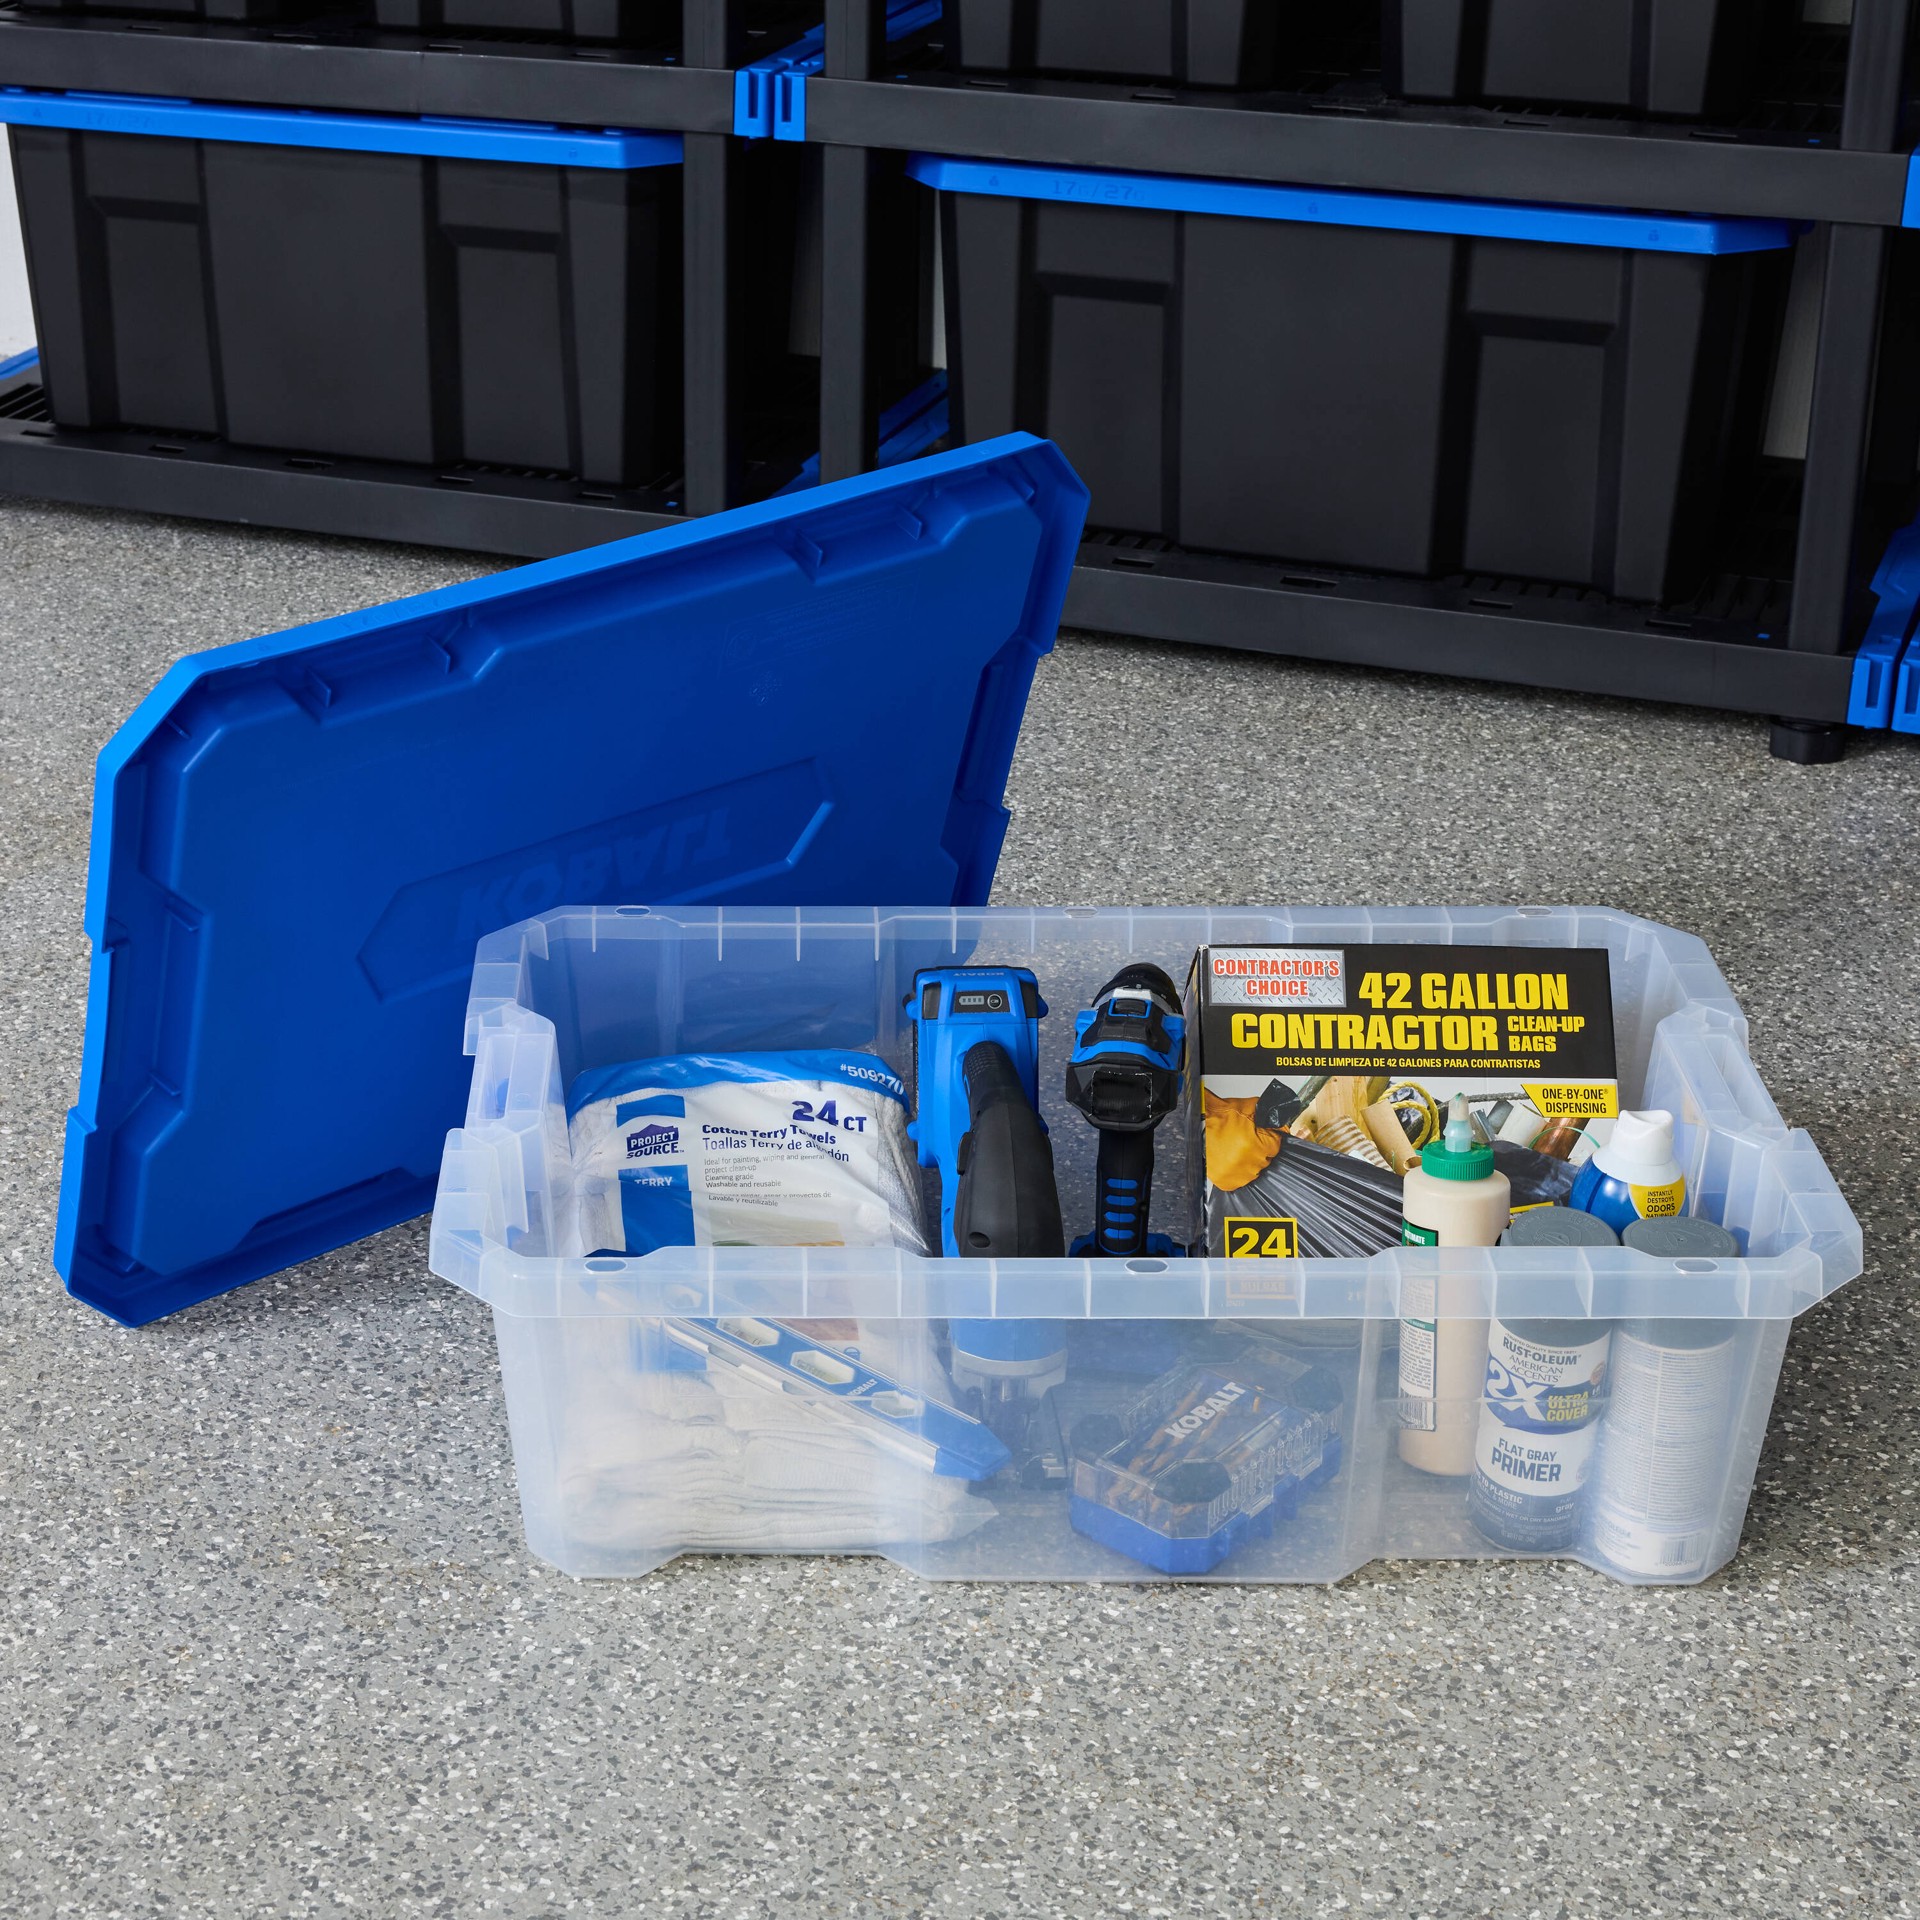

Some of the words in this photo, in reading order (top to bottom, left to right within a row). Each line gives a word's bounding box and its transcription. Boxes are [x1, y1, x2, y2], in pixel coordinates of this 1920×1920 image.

[1213, 959, 1341, 977] CONTRACTOR'S
[1246, 980, 1309, 996] CHOICE
[1358, 972, 1413, 1009] 42
[1420, 973, 1569, 1010] GALLON
[1231, 1013, 1499, 1051] CONTRACTOR
[1507, 1015, 1586, 1033] CLEAN-UP
[1508, 1035, 1557, 1052] BAGS
[1276, 1057, 1312, 1067] BOLSAS
[1314, 1057, 1327, 1067] DE
[1328, 1057, 1371, 1068] LIMPIEZA
[1373, 1058, 1386, 1067] DE
[1387, 1058, 1397, 1067] 42
[1399, 1058, 1442, 1068] GALONES
[1443, 1059, 1469, 1068] PARA
[1471, 1059, 1541, 1069] CONTRATISTAS
[840, 1064, 905, 1096] #509270
[792, 1100, 839, 1127] 24
[844, 1116, 867, 1133] CT
[1546, 1102, 1607, 1114] DISPENSING
[631, 1131, 676, 1149] PROJECT
[702, 1124, 748, 1136] Cotton
[750, 1125, 788, 1140] Terry
[702, 1136, 747, 1151] Toallas
[751, 1138, 784, 1151] Terry
[787, 1139, 802, 1151] de
[722, 1157, 732, 1165] for
[763, 1154, 785, 1163] wiping
[704, 1166, 728, 1175] project
[705, 1174, 733, 1182] Cleaning
[735, 1173, 754, 1182] grade
[706, 1181, 738, 1189] Washable
[753, 1179, 781, 1188] reusable
[708, 1194, 734, 1203] Lavable
[1647, 1189, 1673, 1198] INSTANTLY
[1646, 1203, 1676, 1213] ODORS
[1232, 1226, 1291, 1259] 24
[1508, 1355, 1564, 1375] AMERICAN
[1510, 1364, 1560, 1383] ACCENTS
[1486, 1358, 1549, 1422] 2X
[1547, 1391, 1589, 1409] ULTRA
[1164, 1381, 1247, 1440] KOBALT
[1546, 1404, 1588, 1422] COVER
[1499, 1437, 1525, 1457] FLAT
[1527, 1449, 1558, 1462] GRAY
[1491, 1446, 1562, 1483] PRIMER
[1489, 1484, 1523, 1505] PLASTIC
[1555, 1502, 1575, 1514] gray
